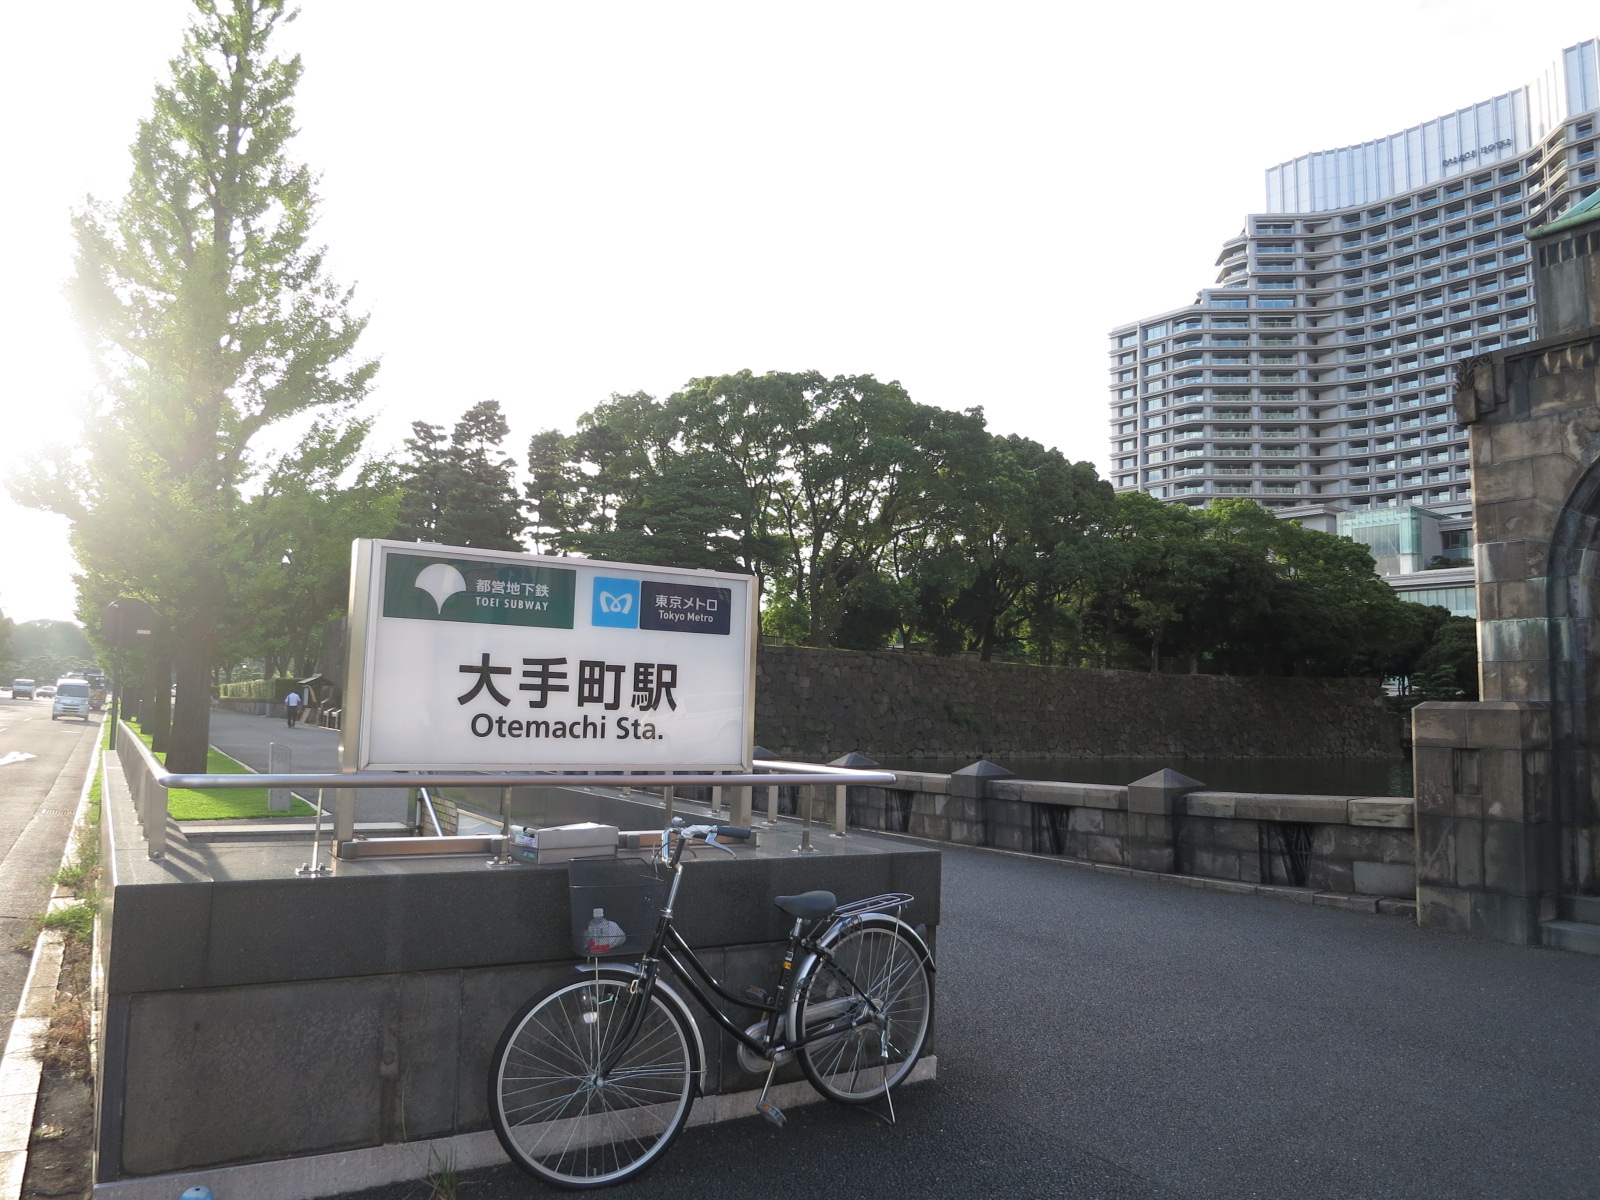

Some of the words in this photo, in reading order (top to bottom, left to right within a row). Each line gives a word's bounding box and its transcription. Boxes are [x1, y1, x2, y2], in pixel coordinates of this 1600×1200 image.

[476, 579, 550, 598] 都営地下鉄
[475, 596, 499, 608] TOEI
[504, 599, 549, 611] SUBWAY
[655, 594, 718, 612] 東京メトロ
[658, 609, 685, 623] Tokyo
[687, 612, 714, 623] Metro
[458, 652, 678, 711] 大手町駅
[471, 713, 606, 740] Otemachi
[616, 717, 664, 740] Sta.
